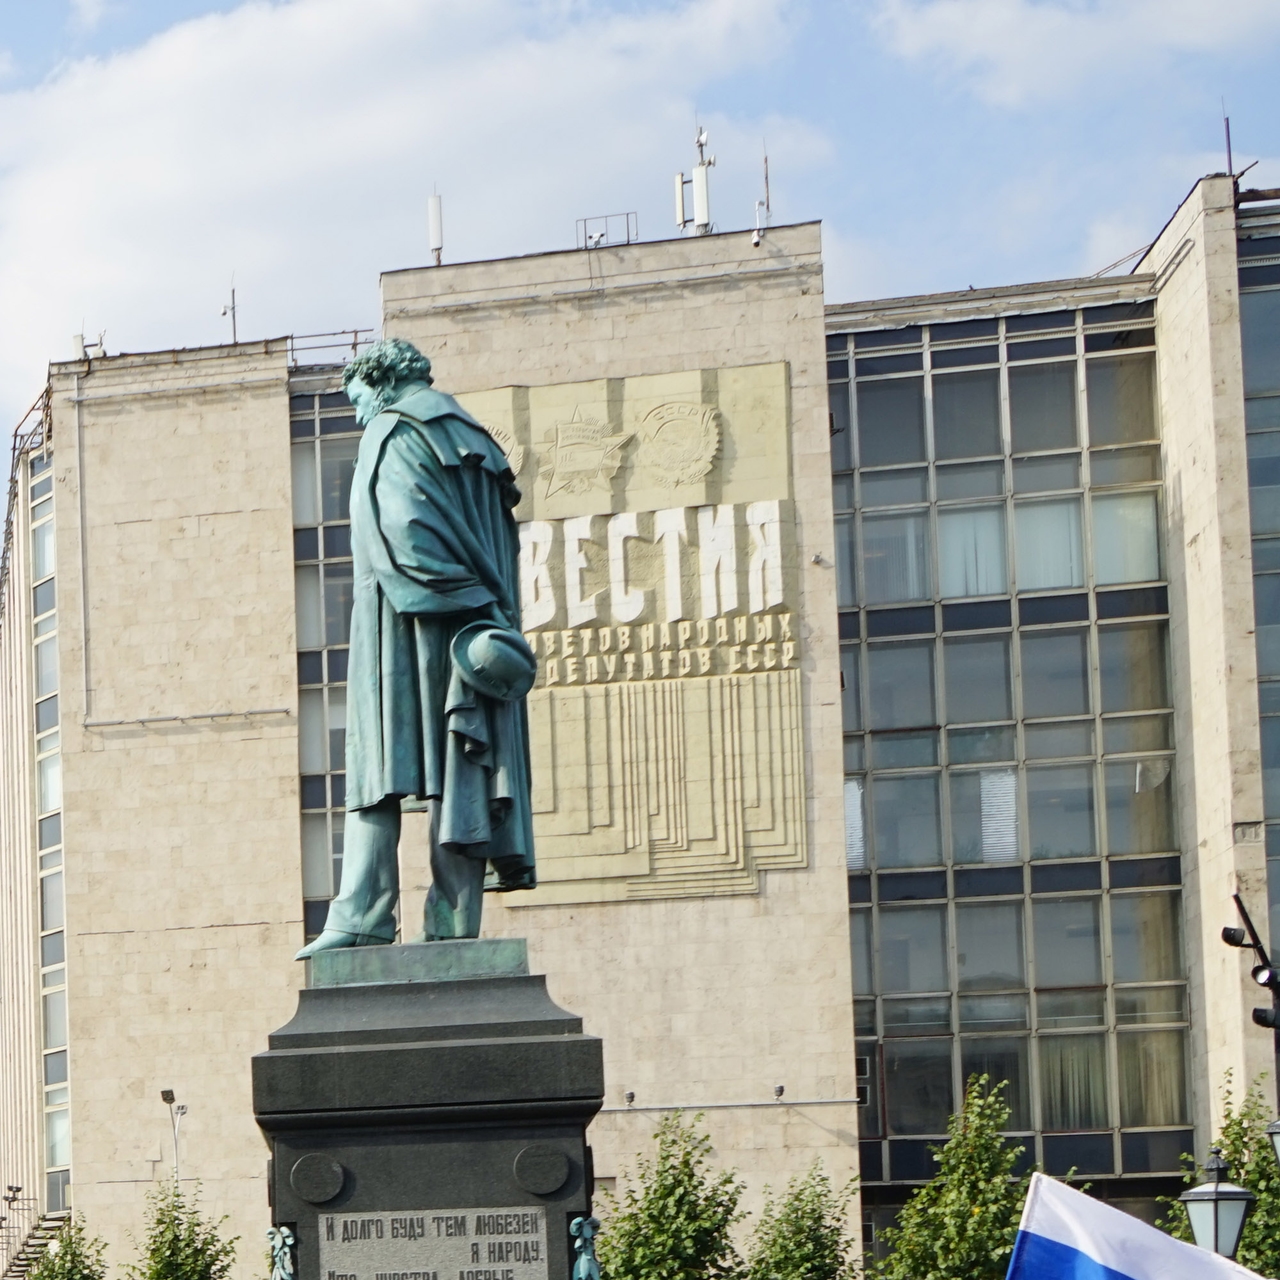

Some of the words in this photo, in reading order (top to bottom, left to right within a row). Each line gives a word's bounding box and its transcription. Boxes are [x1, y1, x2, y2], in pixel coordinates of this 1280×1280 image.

[641, 613, 791, 653] НАРОДНЫХ
[546, 648, 711, 687] ДЕПУТАТОВ
[729, 641, 796, 674] СССР
[325, 1217, 334, 1241] И
[342, 1217, 383, 1243] ДОЛГО
[391, 1216, 425, 1241] БУДУ
[432, 1215, 467, 1237] ТЕМ
[475, 1213, 539, 1236] ЛЮБЕЗЕН
[471, 1242, 480, 1263] Я
